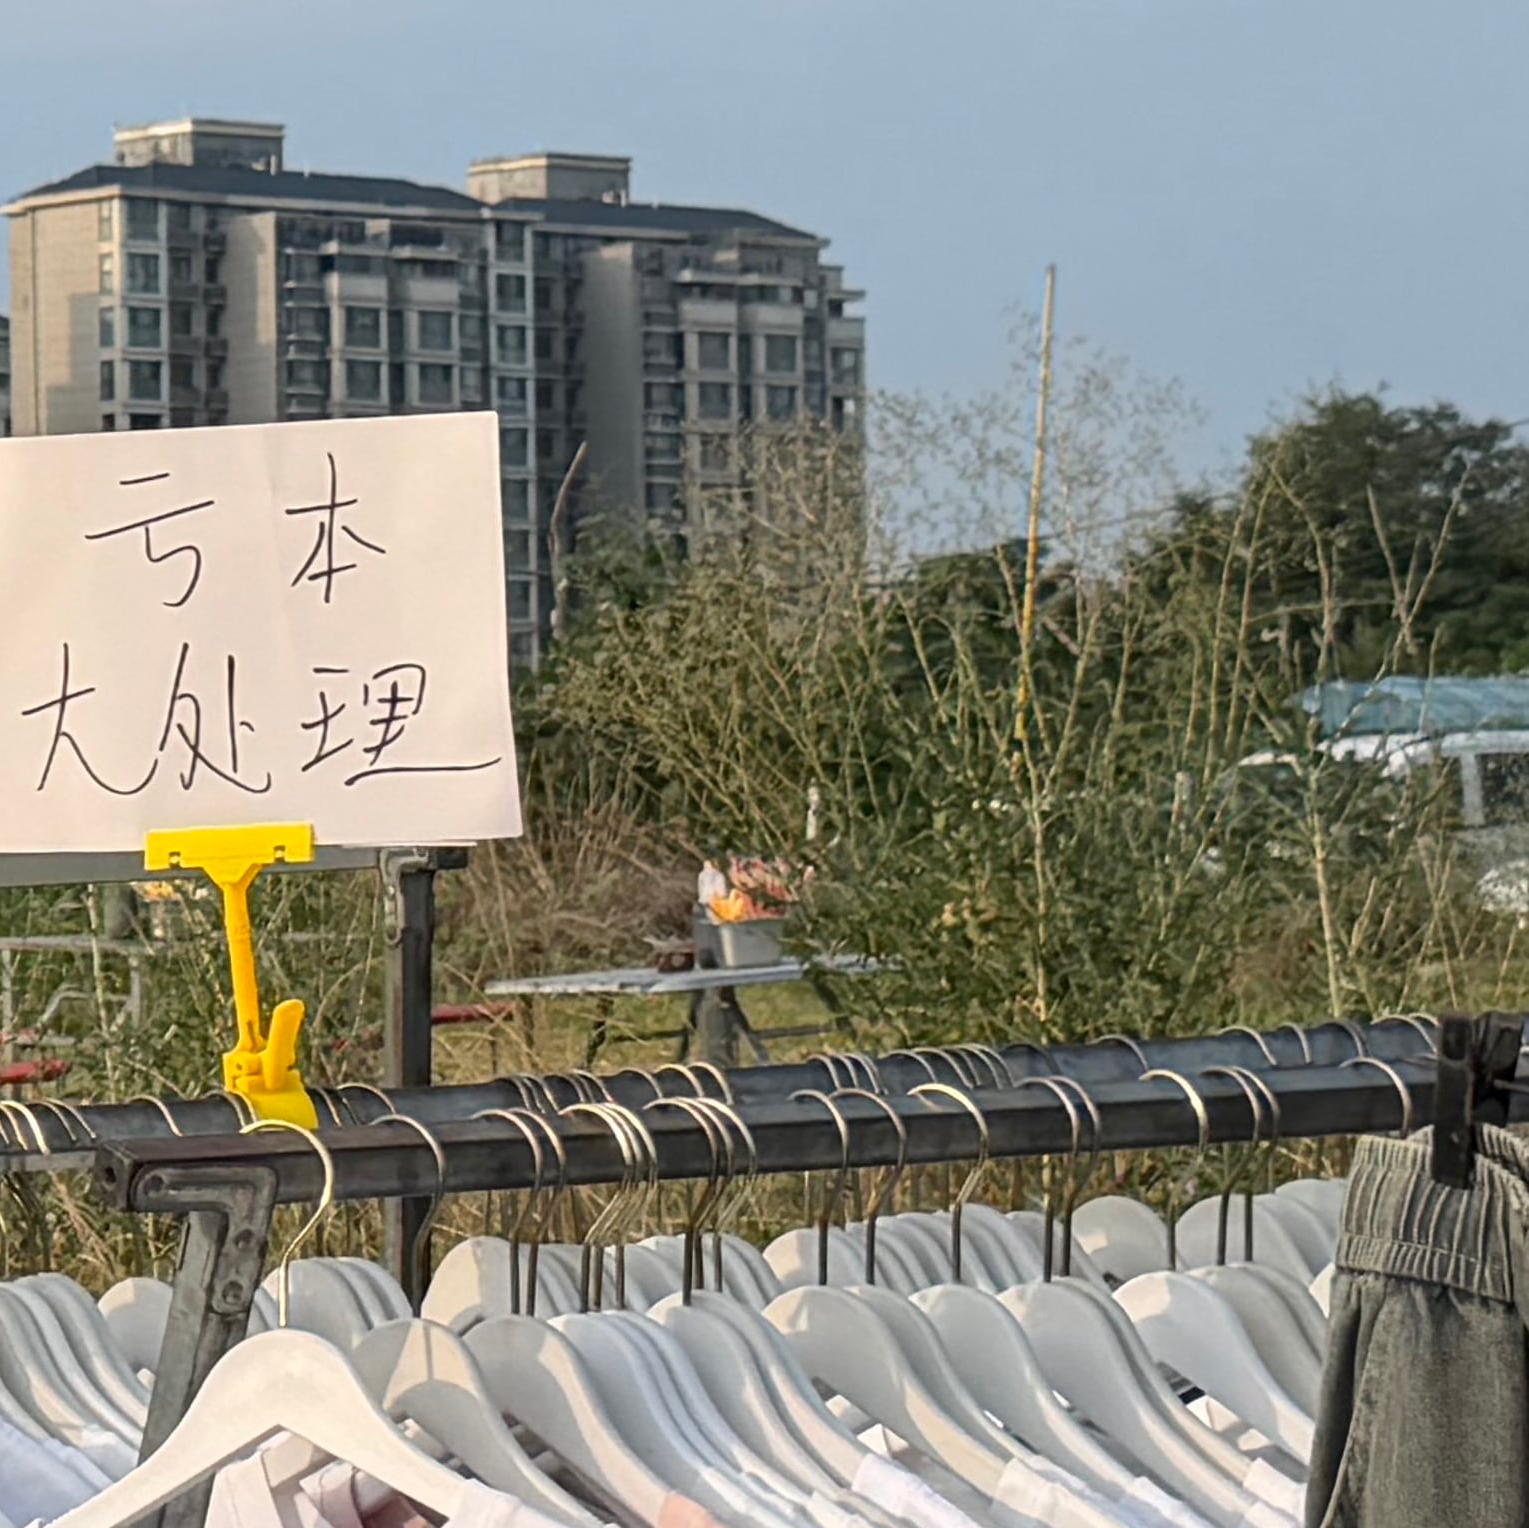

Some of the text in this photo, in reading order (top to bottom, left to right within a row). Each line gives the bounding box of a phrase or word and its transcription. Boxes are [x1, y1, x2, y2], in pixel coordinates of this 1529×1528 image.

[85, 452, 386, 607] 亏本
[21, 642, 502, 795] 大处理
